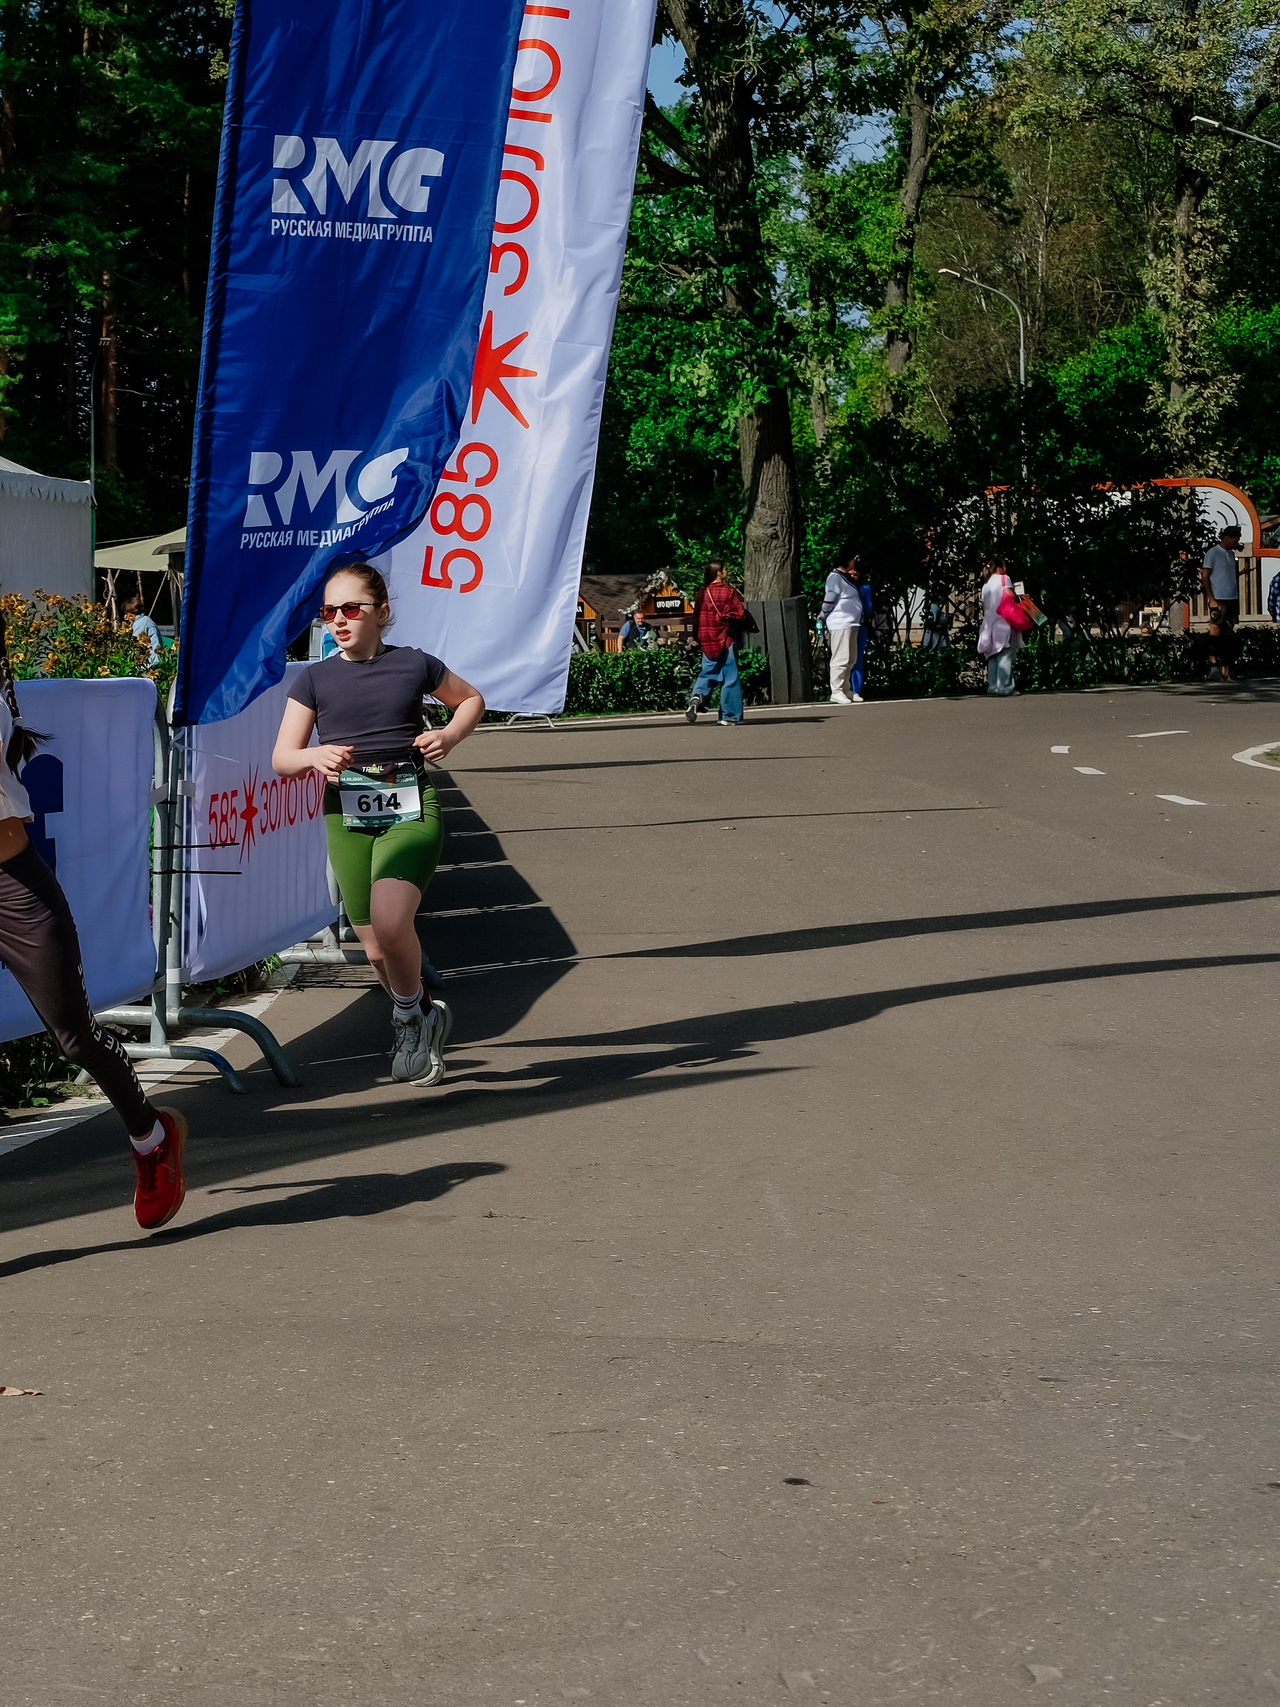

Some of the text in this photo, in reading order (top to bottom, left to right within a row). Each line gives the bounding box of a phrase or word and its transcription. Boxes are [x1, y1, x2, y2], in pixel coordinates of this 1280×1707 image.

[271, 135, 445, 219] RMG
[271, 218, 433, 243] РУССКАЯ МЕДИАГРУППА
[243, 447, 409, 527] RMG
[421, 442, 499, 594] 585
[240, 497, 395, 549] РУССКАЯ МЕДИАГРУППА
[208, 789, 239, 851] 585
[357, 792, 402, 813] 614
